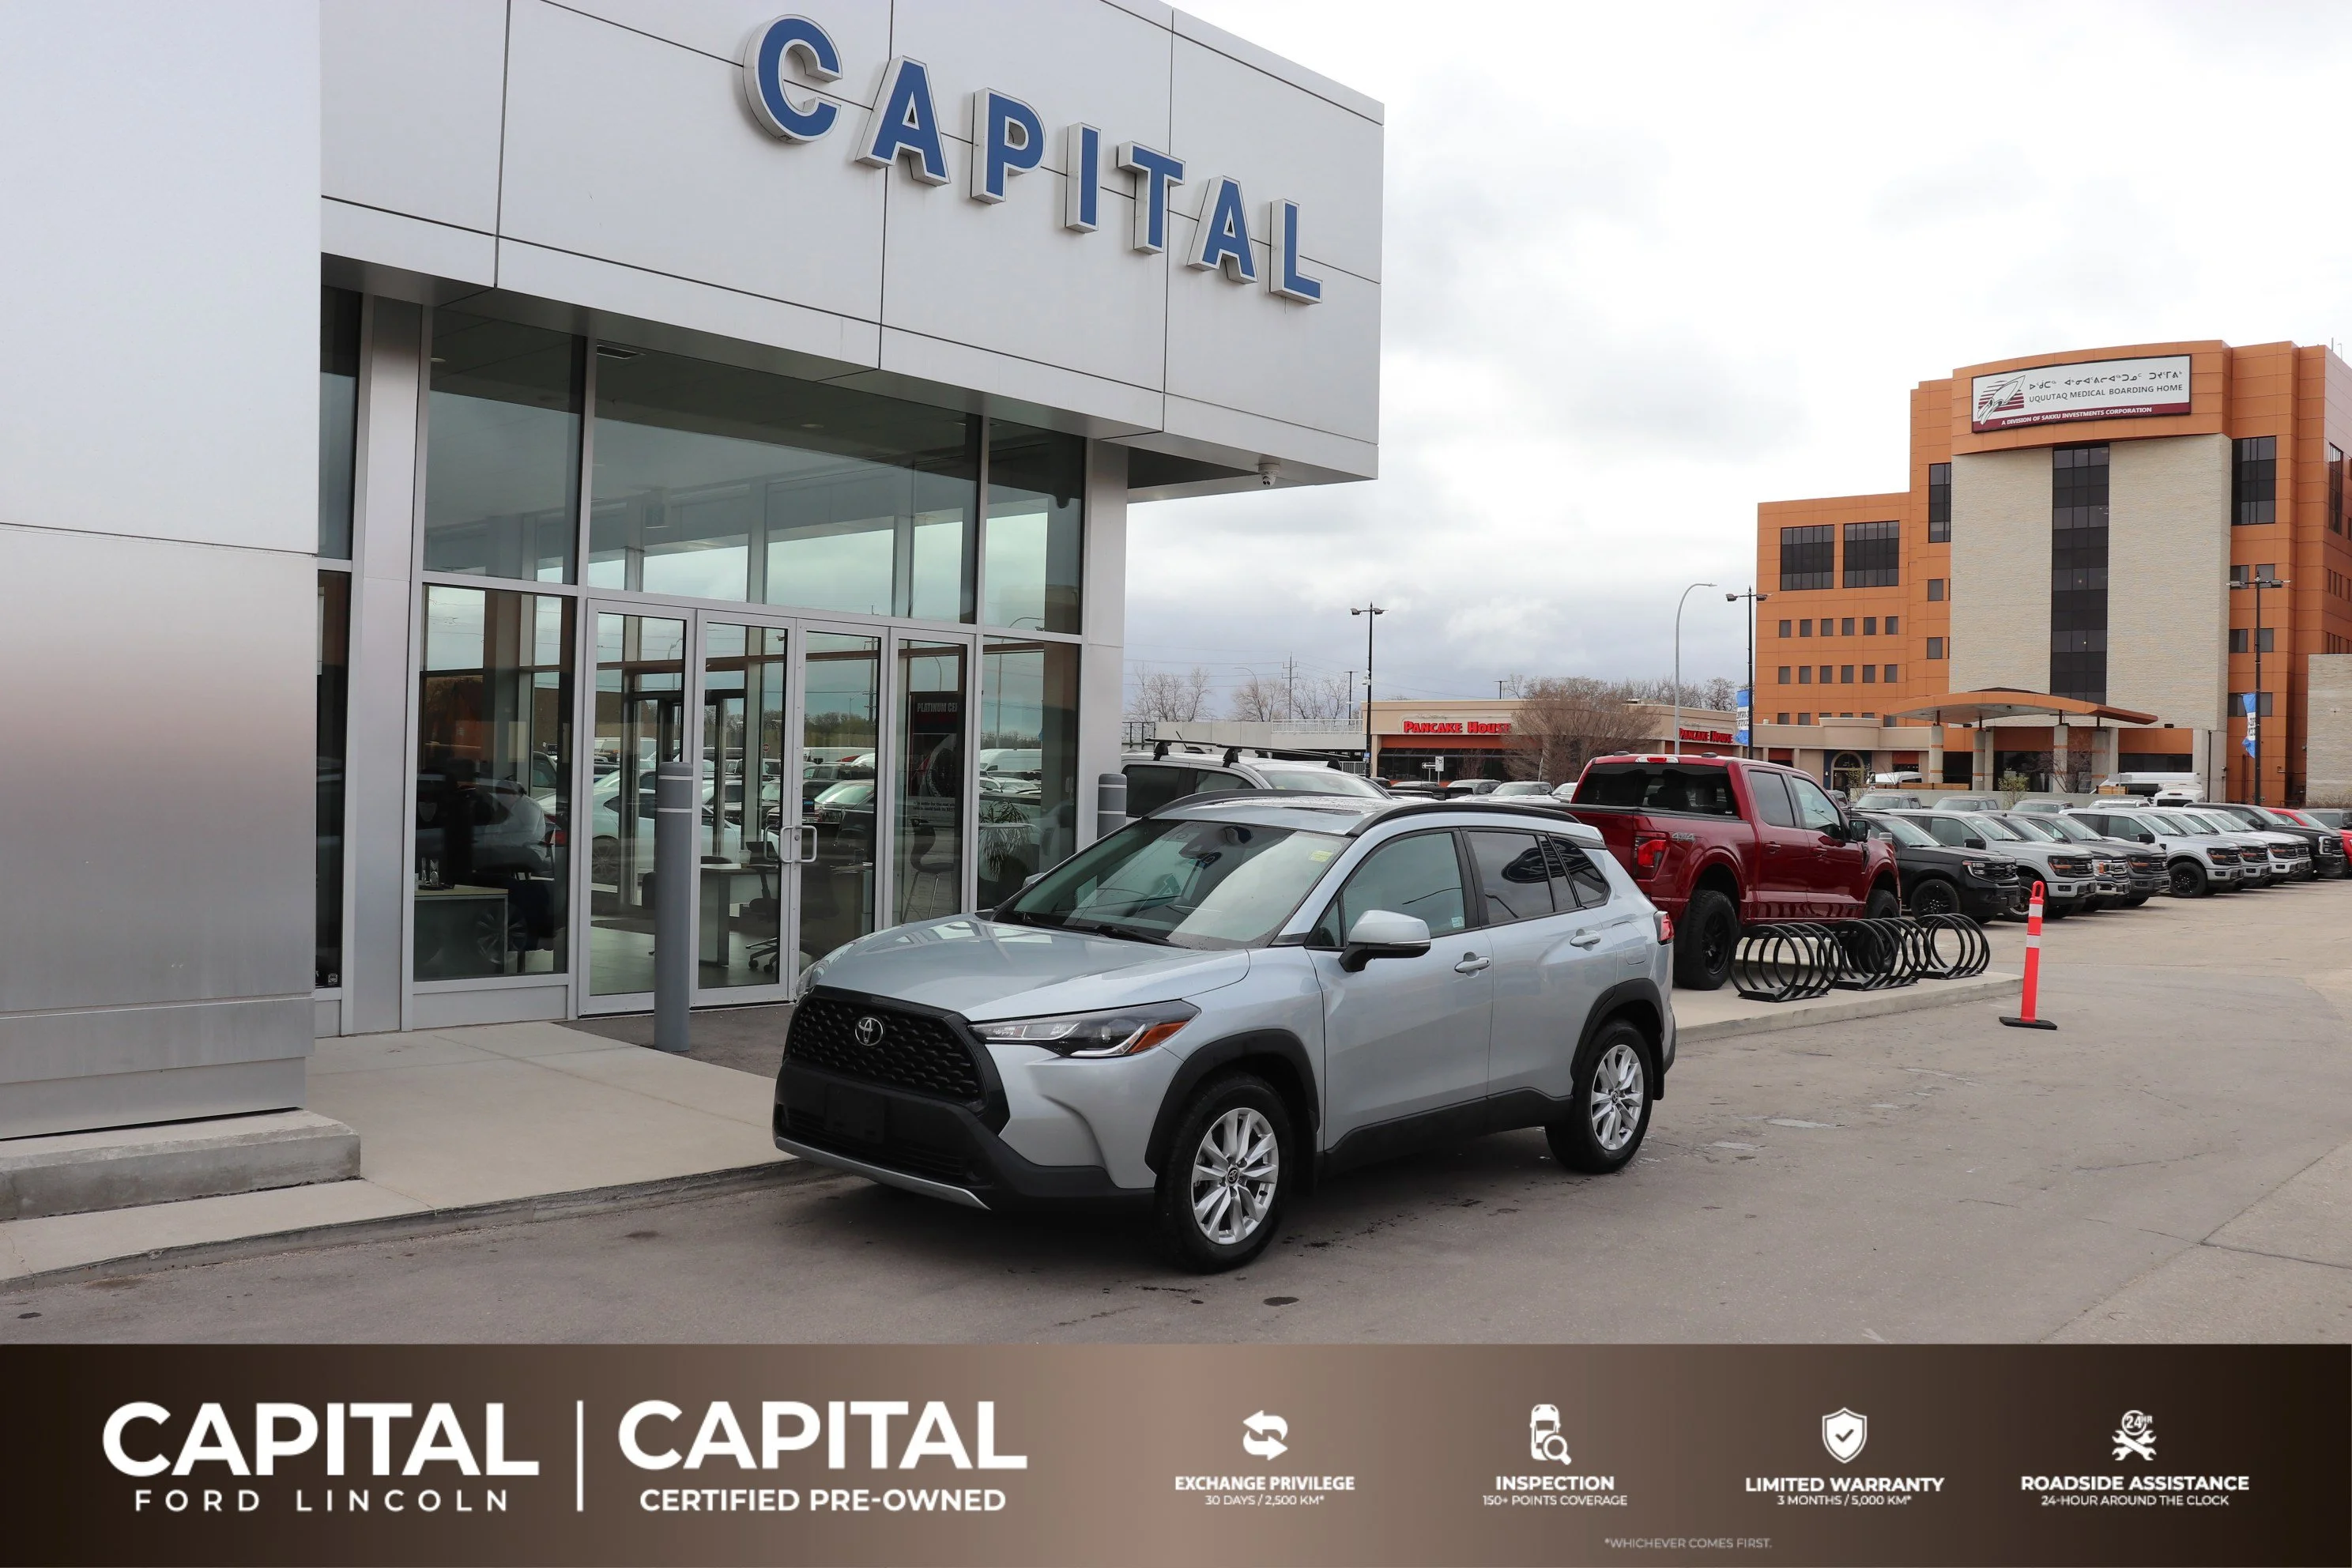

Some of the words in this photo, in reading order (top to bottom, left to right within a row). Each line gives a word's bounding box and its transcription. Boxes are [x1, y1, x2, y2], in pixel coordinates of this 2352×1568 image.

[744, 14, 1323, 304] CAPITAL
[2029, 392, 2067, 403] UQUUTAQ
[2070, 390, 2105, 398] MEDICAL
[2109, 386, 2154, 395] BOARDING
[2062, 409, 2104, 418] INVESTMENTS
[917, 703, 947, 712] PLATINUM
